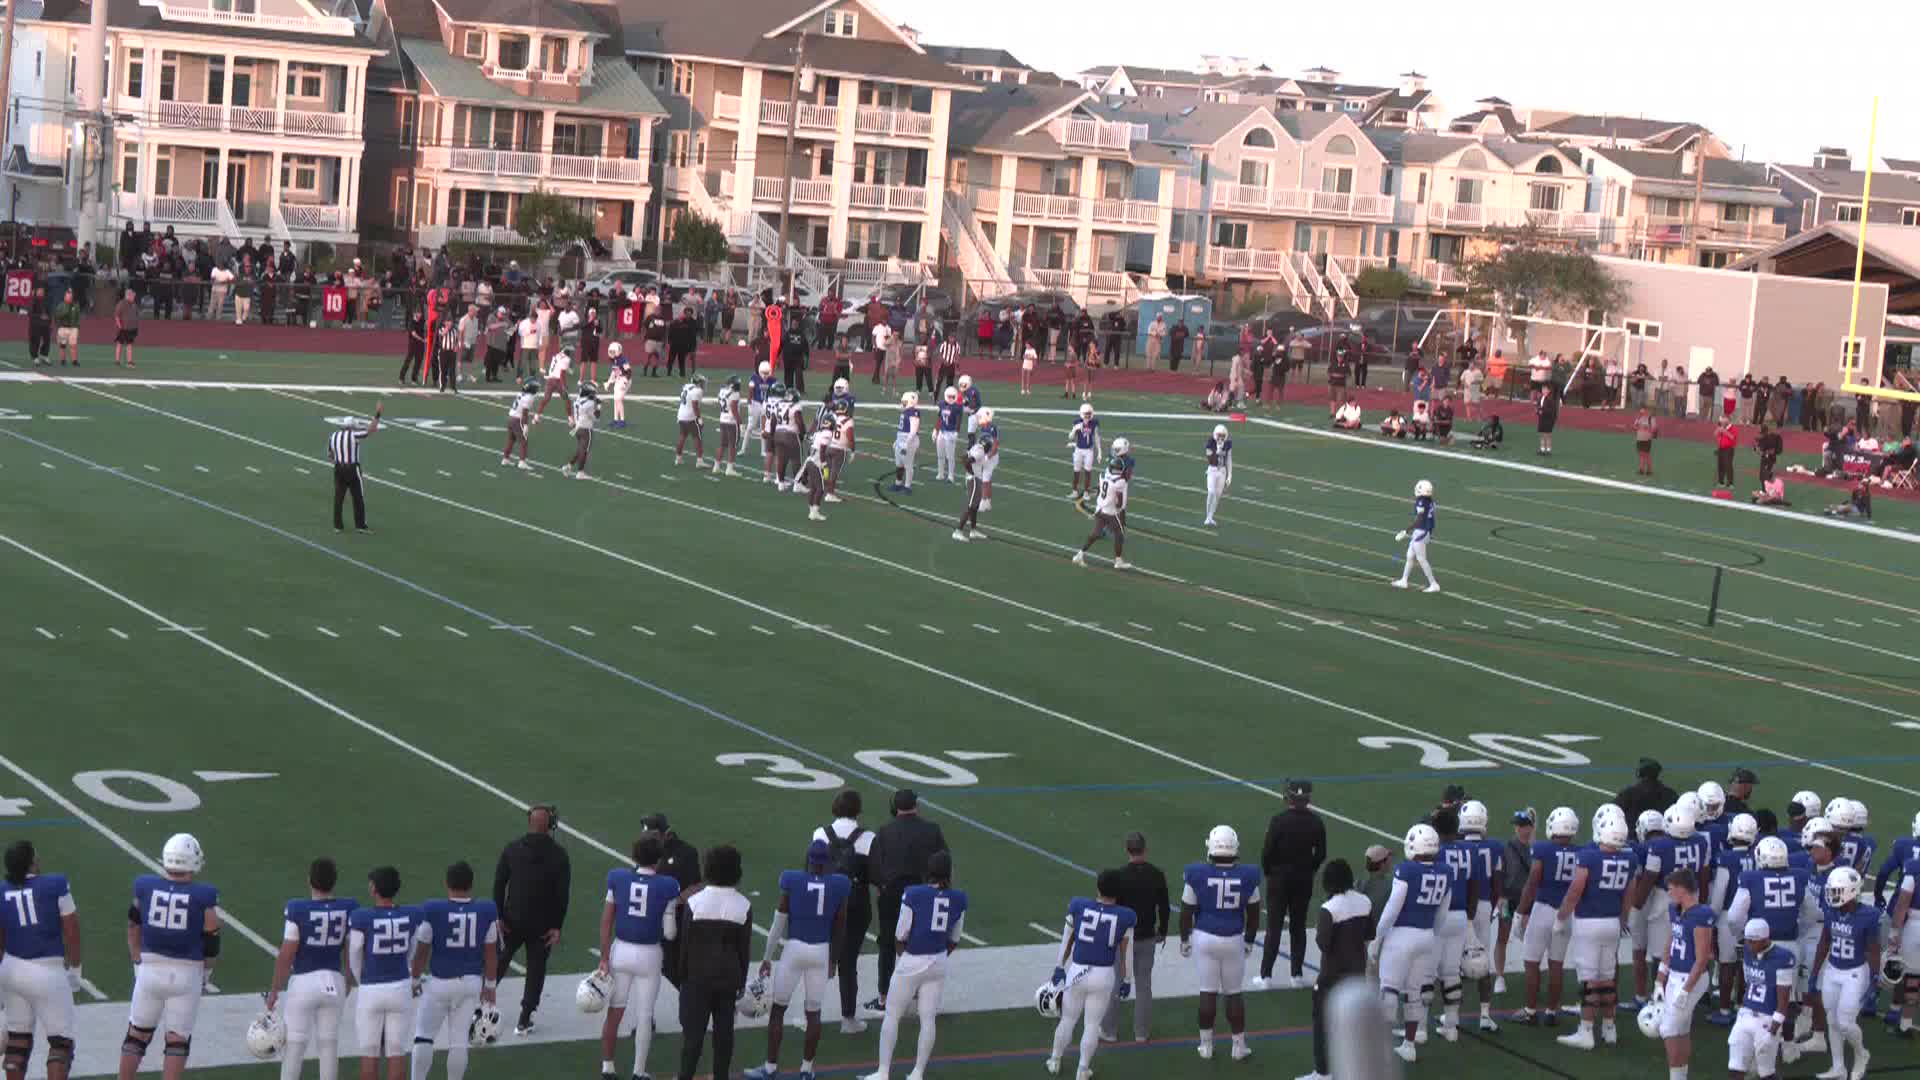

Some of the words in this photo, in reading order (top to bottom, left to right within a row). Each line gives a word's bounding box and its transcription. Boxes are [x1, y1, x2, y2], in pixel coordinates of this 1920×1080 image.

[8, 277, 33, 297] 20
[326, 293, 343, 312] 10
[1101, 480, 1109, 499] 9
[1357, 732, 1594, 769] 20
[714, 749, 980, 790] 30
[1554, 851, 1577, 881] 19
[1599, 858, 1630, 889] 56
[628, 882, 649, 917] 9
[806, 882, 826, 916] 7
[1207, 877, 1241, 910] 75
[1416, 873, 1448, 905] 58
[1763, 875, 1797, 908] 52
[4, 888, 38, 927] 71
[148, 889, 191, 930] 66
[930, 897, 950, 932] 6
[306, 910, 348, 946] 33
[372, 915, 410, 955] 25
[445, 911, 478, 948] 31
[1078, 907, 1119, 948] 27
[1831, 921, 1853, 934] IMG
[1830, 936, 1856, 960] 26
